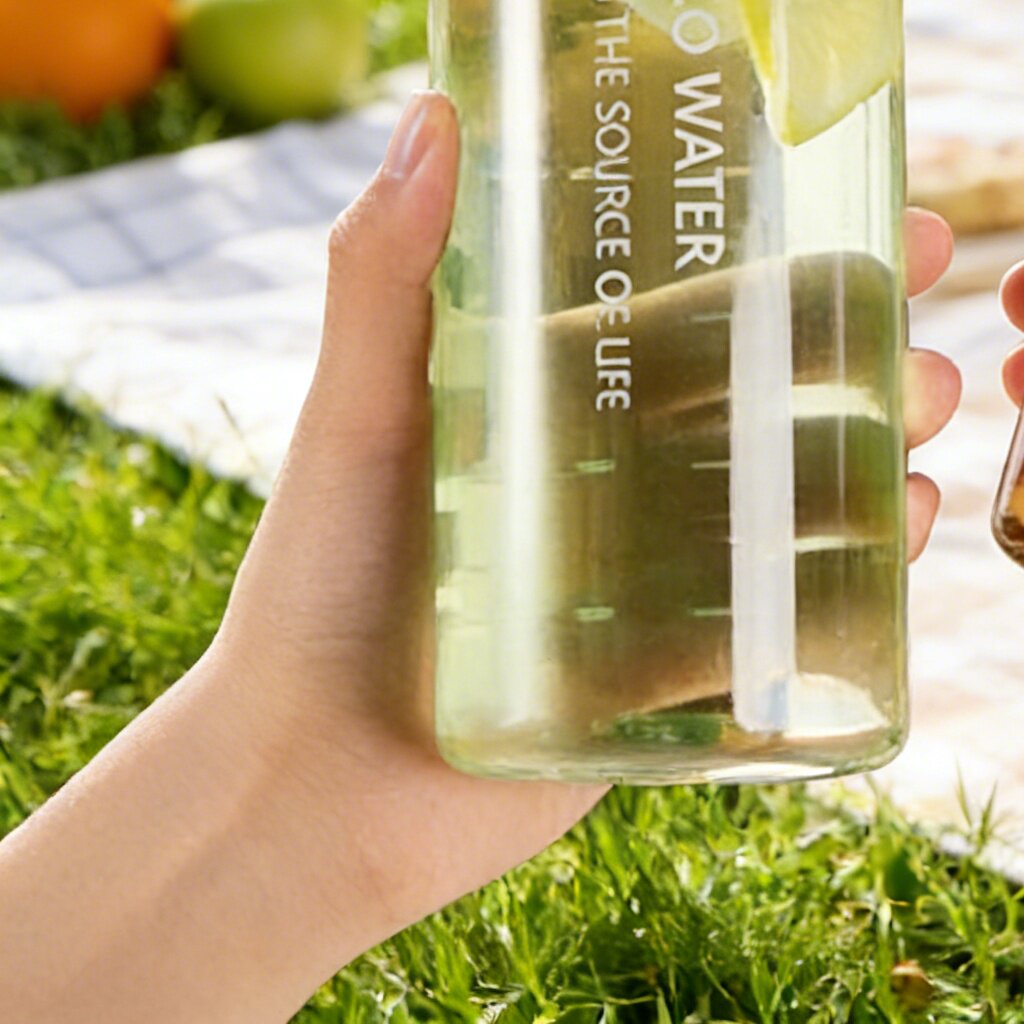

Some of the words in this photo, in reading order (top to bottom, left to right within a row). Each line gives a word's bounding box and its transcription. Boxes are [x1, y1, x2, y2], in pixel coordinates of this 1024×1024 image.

[593, 10, 634, 88] THE
[594, 100, 632, 259] SOURCE
[672, 71, 726, 272] WATER
